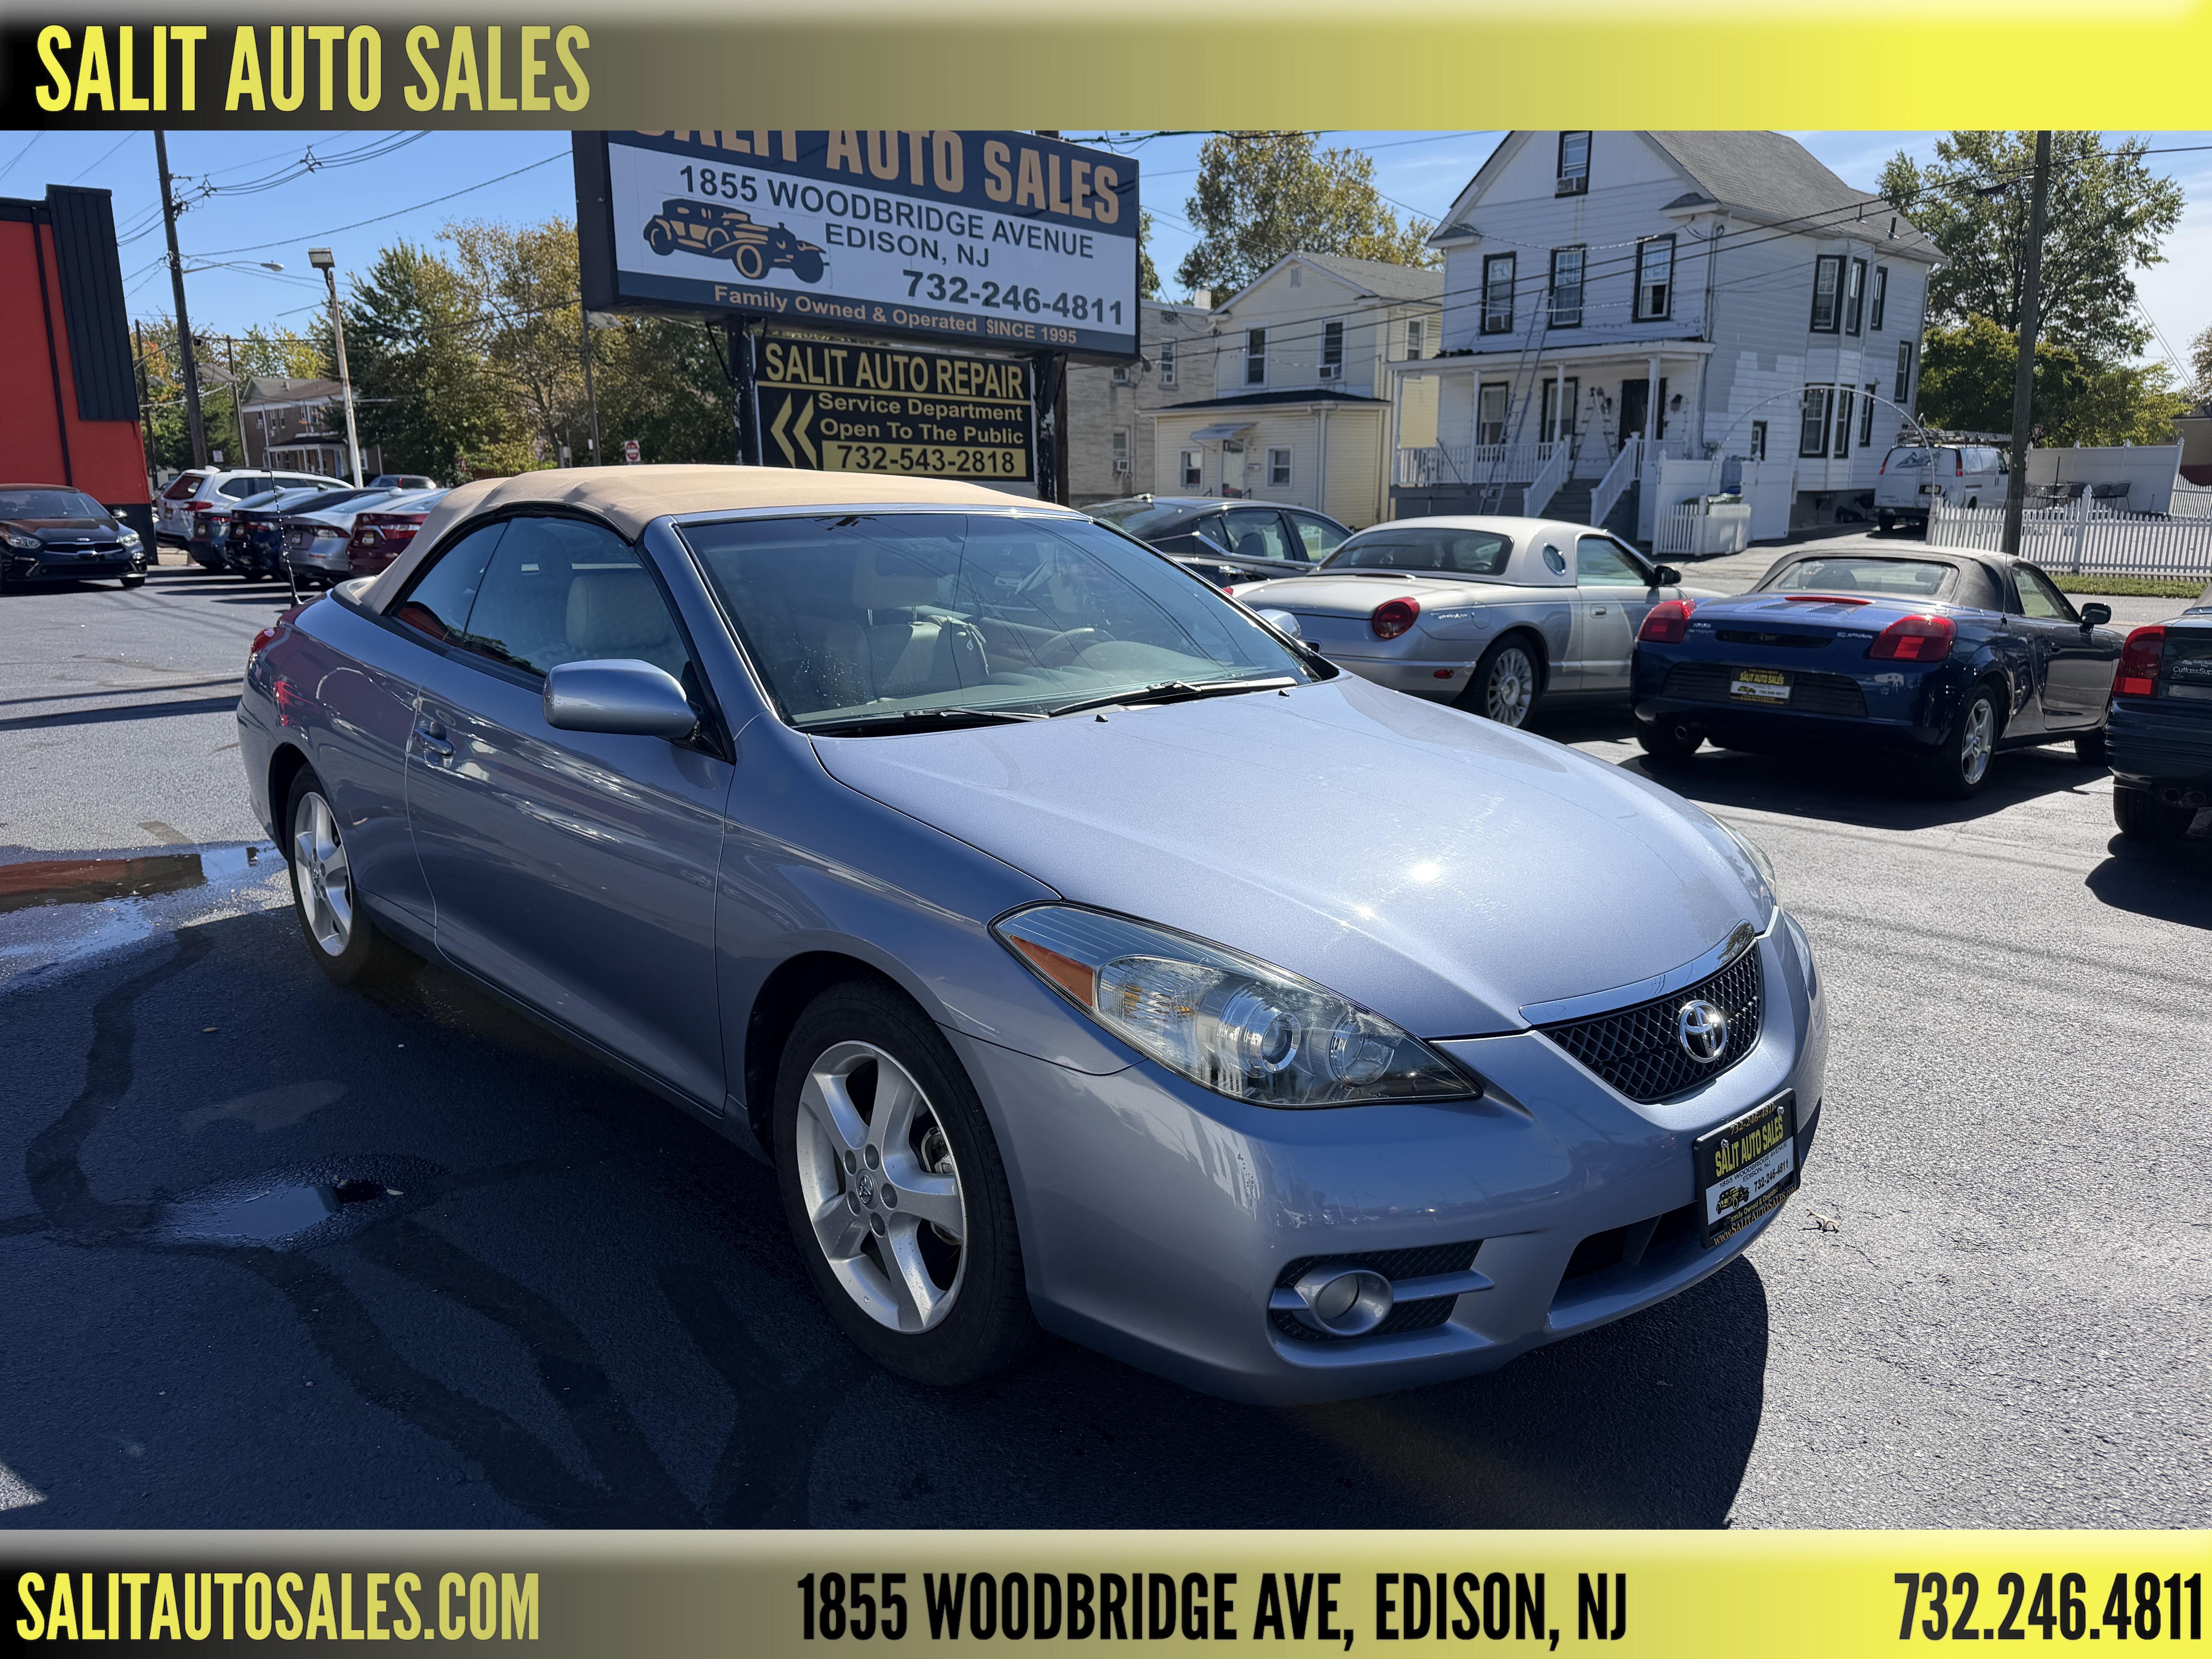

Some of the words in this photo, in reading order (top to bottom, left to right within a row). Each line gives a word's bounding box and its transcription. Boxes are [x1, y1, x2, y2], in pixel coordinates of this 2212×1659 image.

[826, 131, 964, 193] AUTO
[984, 140, 1119, 224] SALES
[680, 165, 757, 202] 1855
[767, 179, 984, 240] WOODBRIDGE
[992, 220, 1094, 259] AVENUE
[825, 222, 947, 265] EDISON,
[957, 243, 989, 267] NJ
[714, 284, 788, 313] Family
[794, 295, 866, 318] Owned
[872, 307, 887, 323] &
[893, 309, 977, 332] Operated
[986, 318, 1036, 339] SINCE
[1041, 327, 1077, 344] 1995
[903, 270, 1121, 325] 732-246-4811
[765, 343, 847, 386] SALIT
[855, 352, 929, 392] AUTO
[936, 359, 1024, 399] REPAIR
[818, 392, 901, 414] Service
[908, 399, 1023, 422] Department
[820, 418, 880, 440] Open
[887, 422, 913, 439] To
[919, 425, 957, 441] The
[964, 426, 1024, 444] Public
[837, 445, 1015, 474] 732-543-2818
[1740, 672, 1754, 682] SALIT
[1754, 673, 1768, 684] AUTO
[1768, 675, 1784, 685] SALES
[1730, 1103, 1774, 1135] 732-246-4811
[1715, 1141, 1739, 1177] SALIT
[1741, 1129, 1761, 1164] AUTO
[1762, 1115, 1783, 1151] SALES
[1719, 1177, 1733, 1188] 1855
[1734, 1154, 1769, 1180] WOODBRIDGE
[1770, 1141, 1787, 1158] AVENUE
[1743, 1166, 1763, 1182] EDISON,
[1764, 1161, 1770, 1169] NJ
[1754, 1158, 1789, 1192] 732-246-4811
[1744, 1200, 1759, 1214] Owned
[1763, 1185, 1779, 1202] Operated
